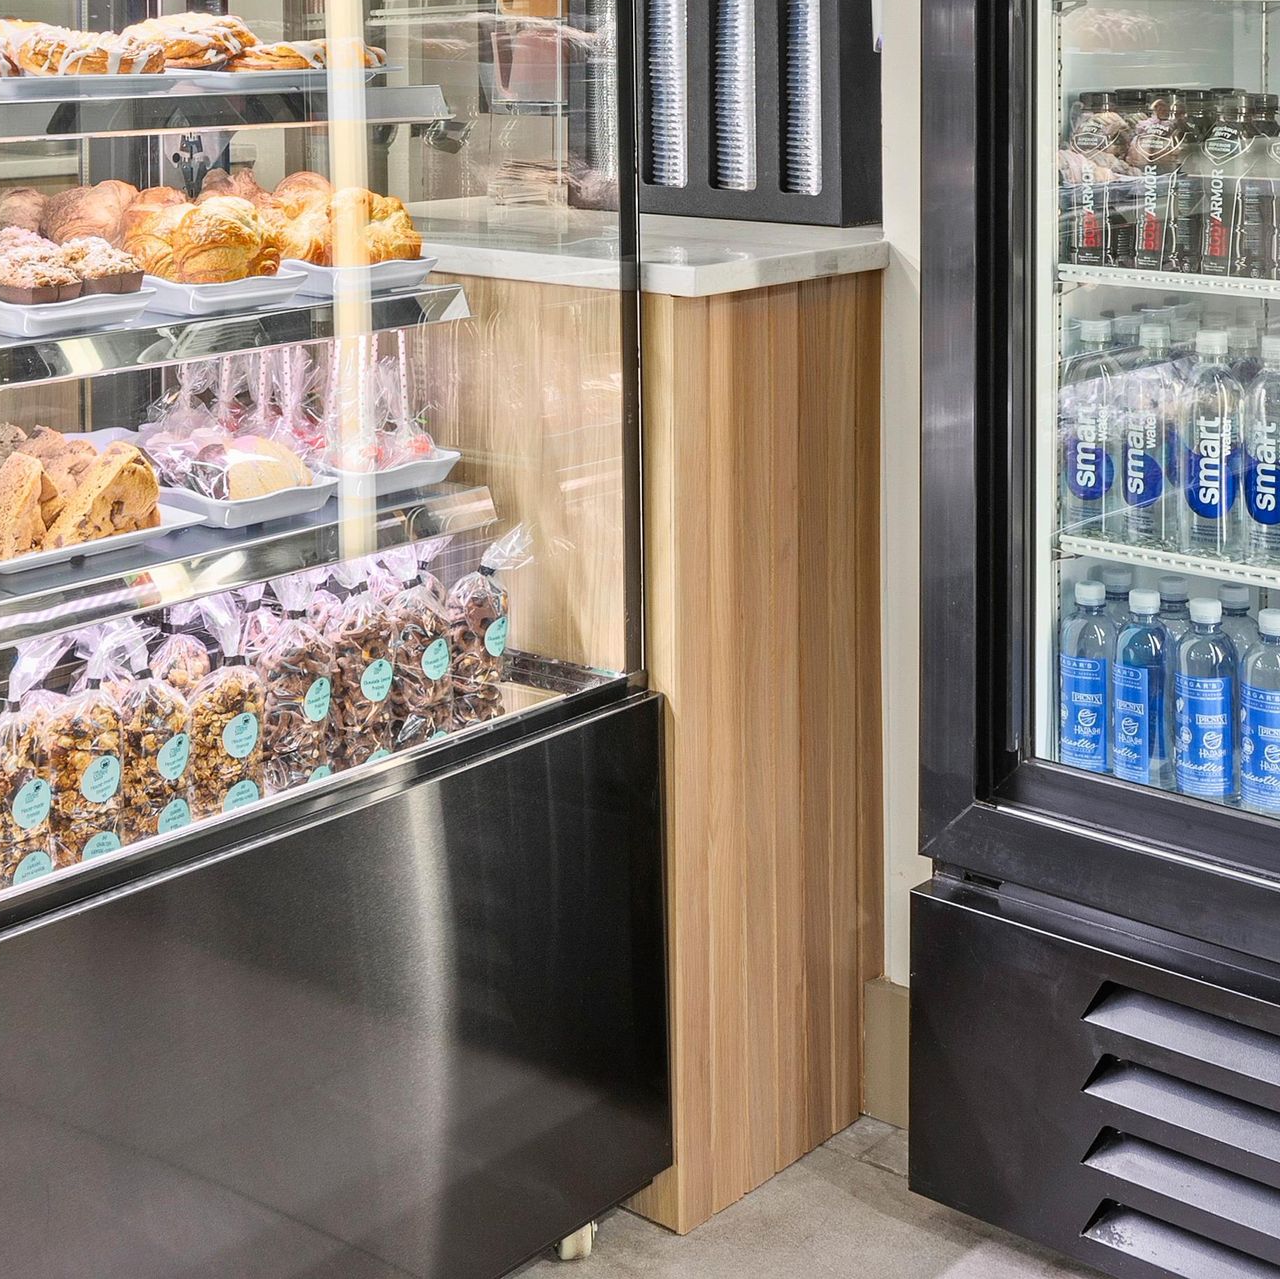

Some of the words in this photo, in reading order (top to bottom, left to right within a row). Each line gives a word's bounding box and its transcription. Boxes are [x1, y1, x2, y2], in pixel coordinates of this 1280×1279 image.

[1196, 416, 1221, 505] smart
[1222, 417, 1232, 456] water
[1256, 422, 1276, 511] smart
